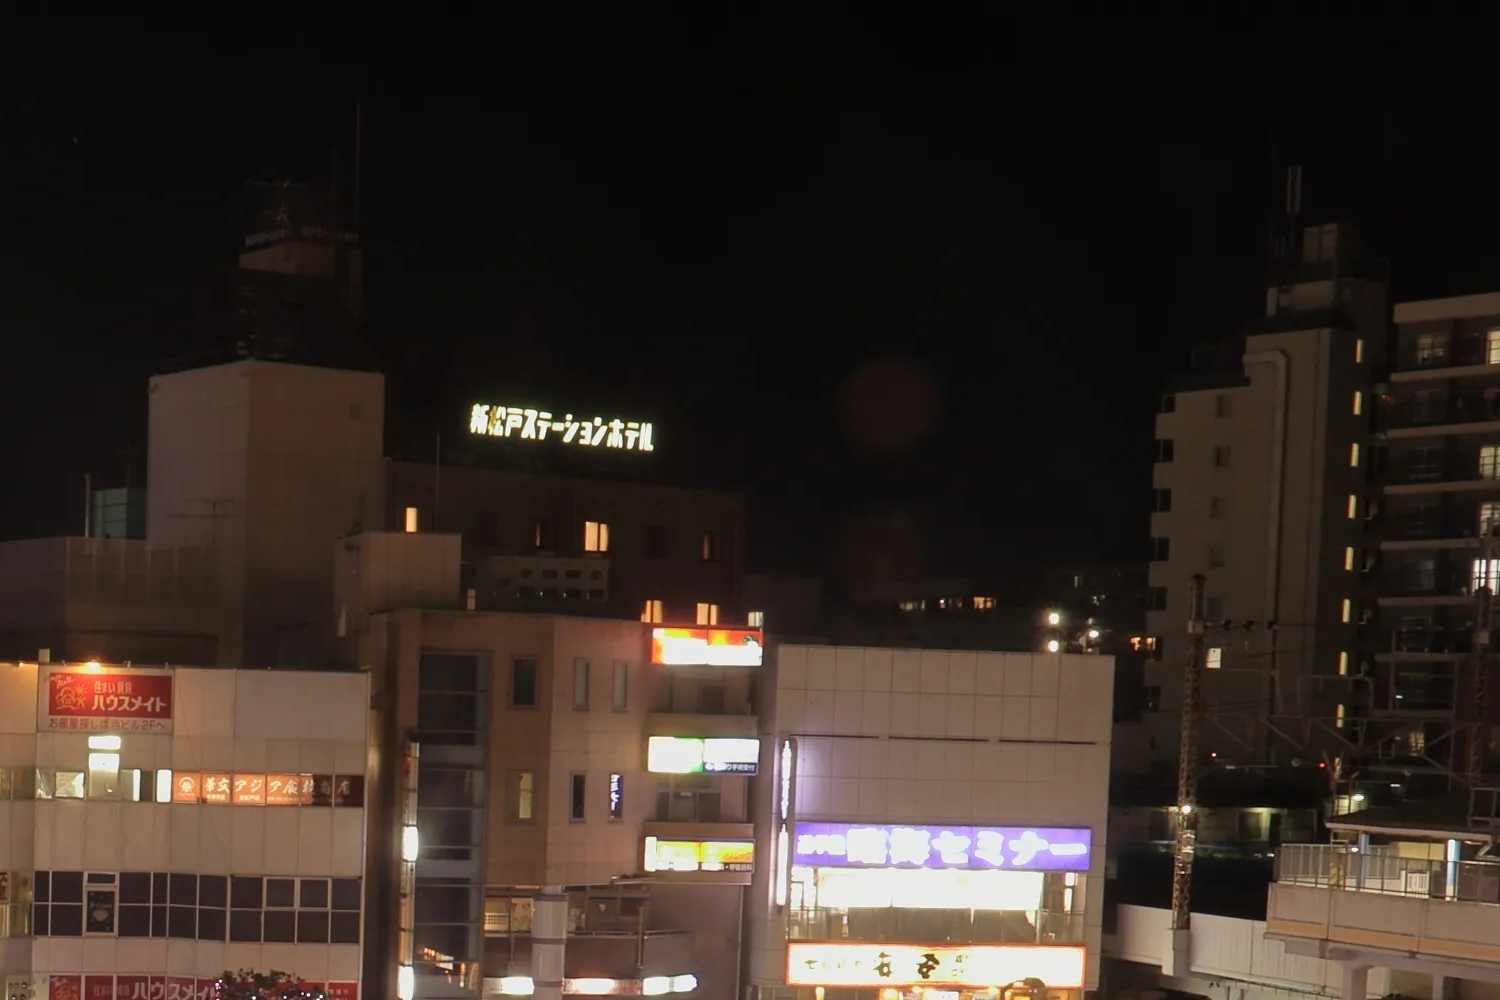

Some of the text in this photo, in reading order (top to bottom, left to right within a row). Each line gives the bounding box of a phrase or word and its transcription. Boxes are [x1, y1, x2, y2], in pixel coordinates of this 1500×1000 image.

[470, 403, 654, 452] 新松戸ステーションホテル
[92, 694, 167, 712] ハウスメイト
[847, 828, 1088, 866] セミナー
